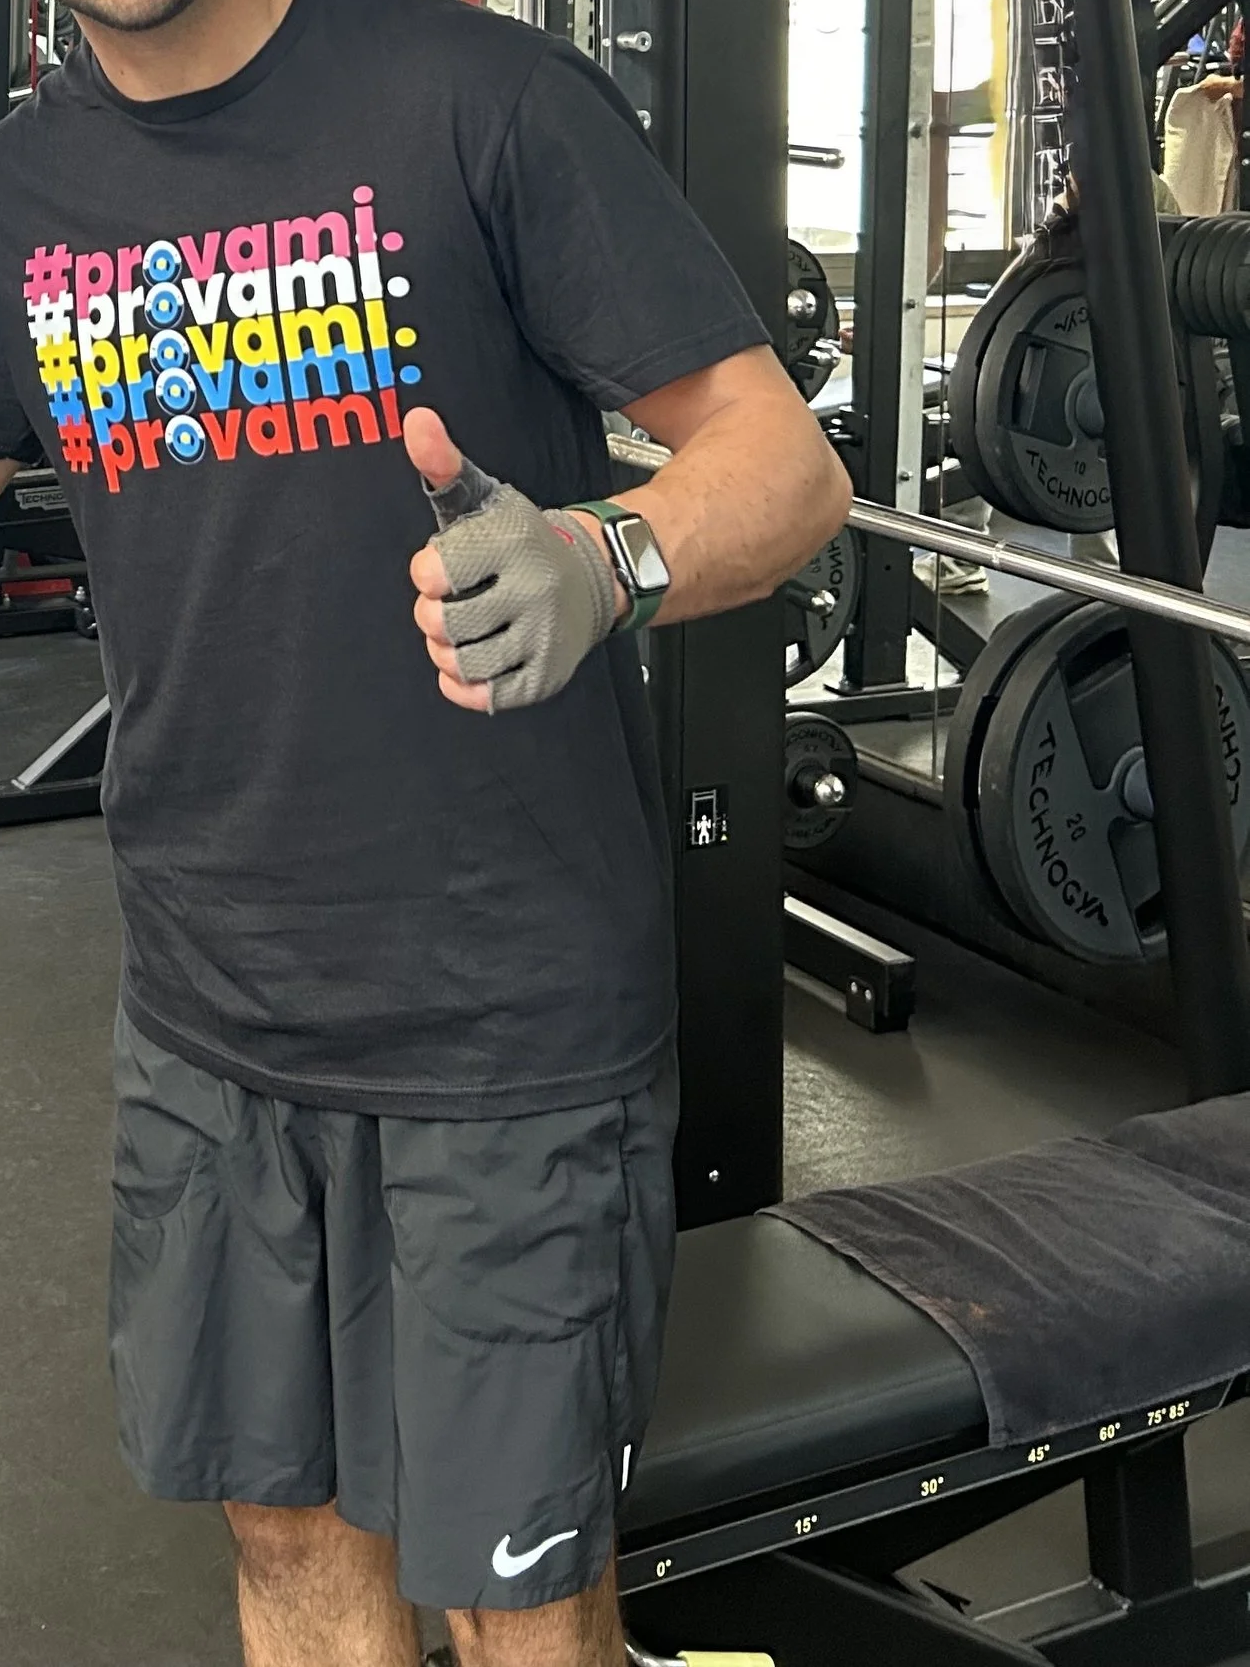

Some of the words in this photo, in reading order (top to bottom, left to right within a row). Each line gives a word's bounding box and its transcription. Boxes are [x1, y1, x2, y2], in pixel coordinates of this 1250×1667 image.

[23, 186, 405, 319] #provami.
[27, 234, 411, 363] #provami.
[36, 300, 418, 410] #provami.
[48, 344, 422, 445] #provami.
[1065, 813, 1086, 841] 20
[655, 1559, 673, 1578] 0°
[795, 1515, 818, 1534] 15°
[921, 1477, 945, 1496] 30°
[1027, 1444, 1051, 1463] 45°
[1099, 1422, 1122, 1441] 60°
[1147, 1407, 1168, 1426] 75°
[1169, 1401, 1190, 1419] 85°
